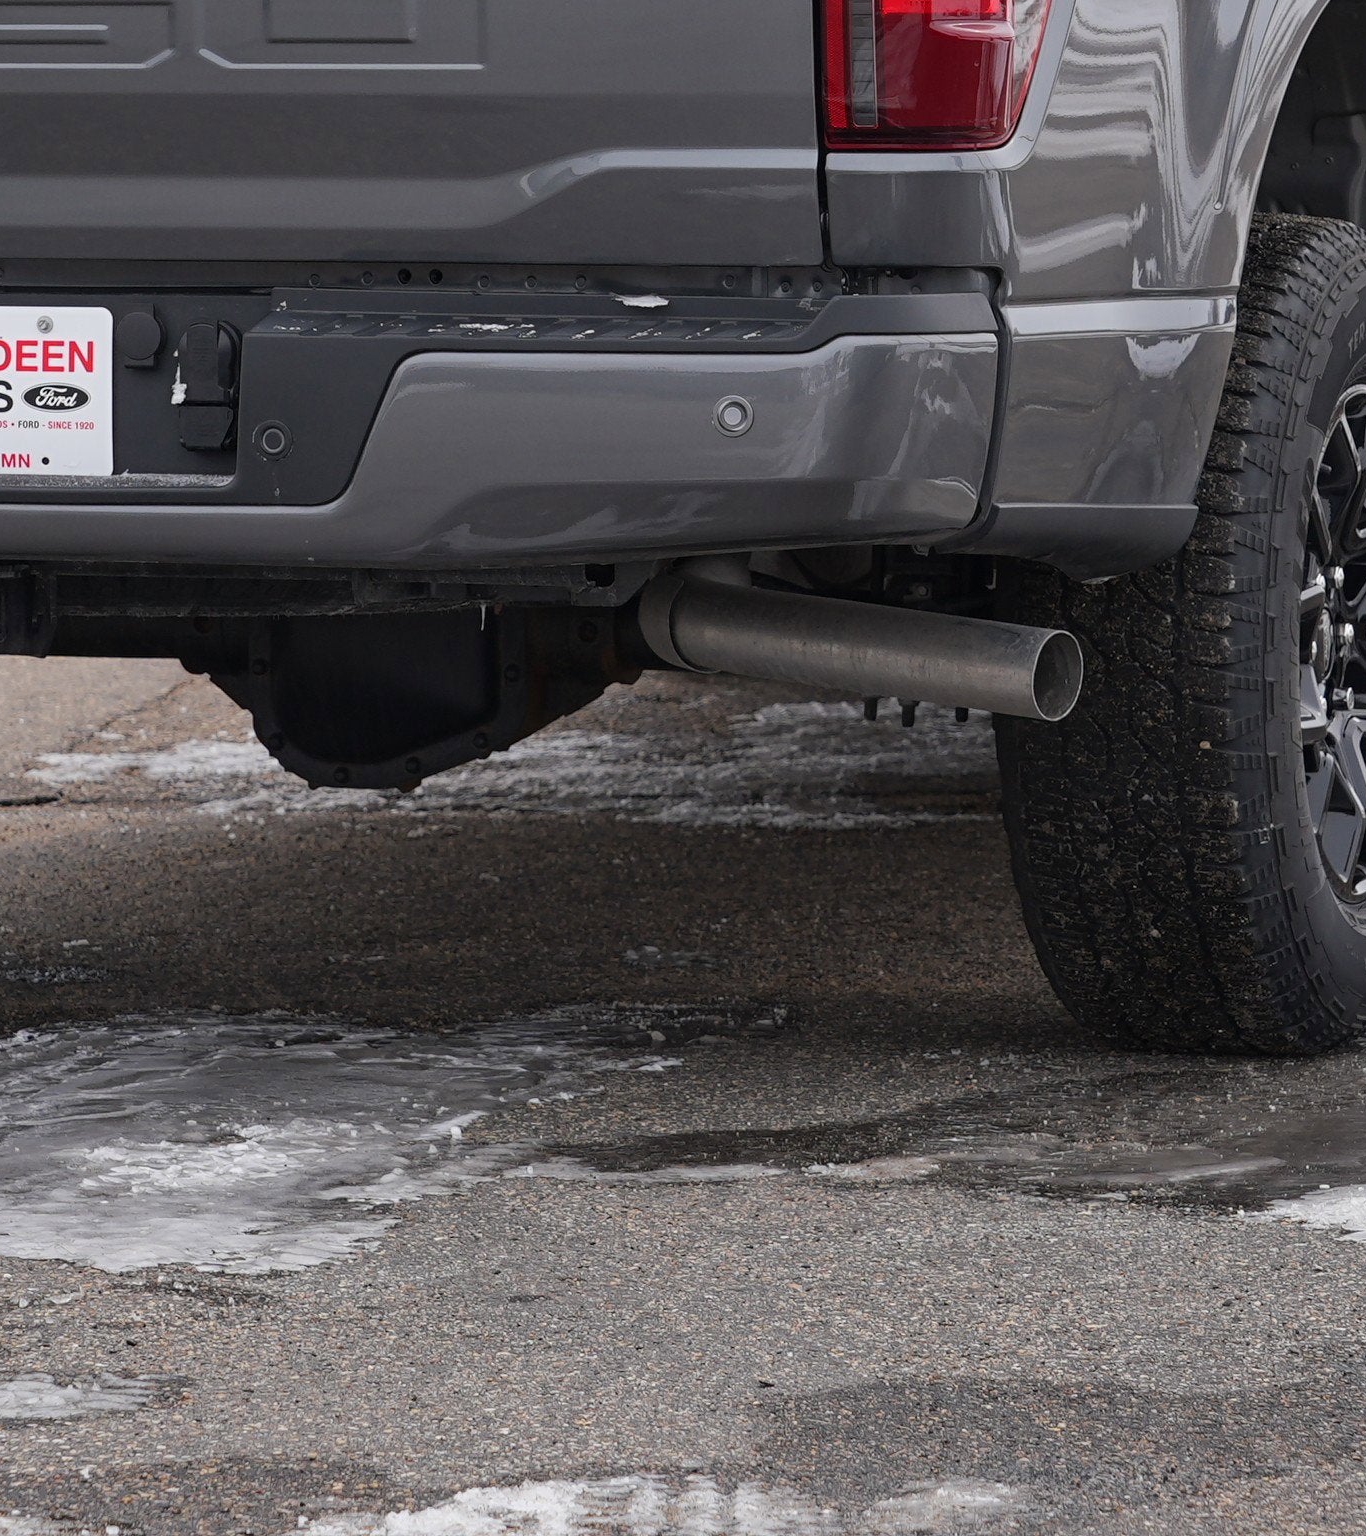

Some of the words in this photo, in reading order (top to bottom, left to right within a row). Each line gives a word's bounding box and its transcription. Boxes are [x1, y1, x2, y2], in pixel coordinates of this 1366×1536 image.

[17, 420, 40, 429] FORD
[47, 421, 73, 430] SINCE
[75, 421, 96, 430] 1920
[0, 453, 32, 468] MN
